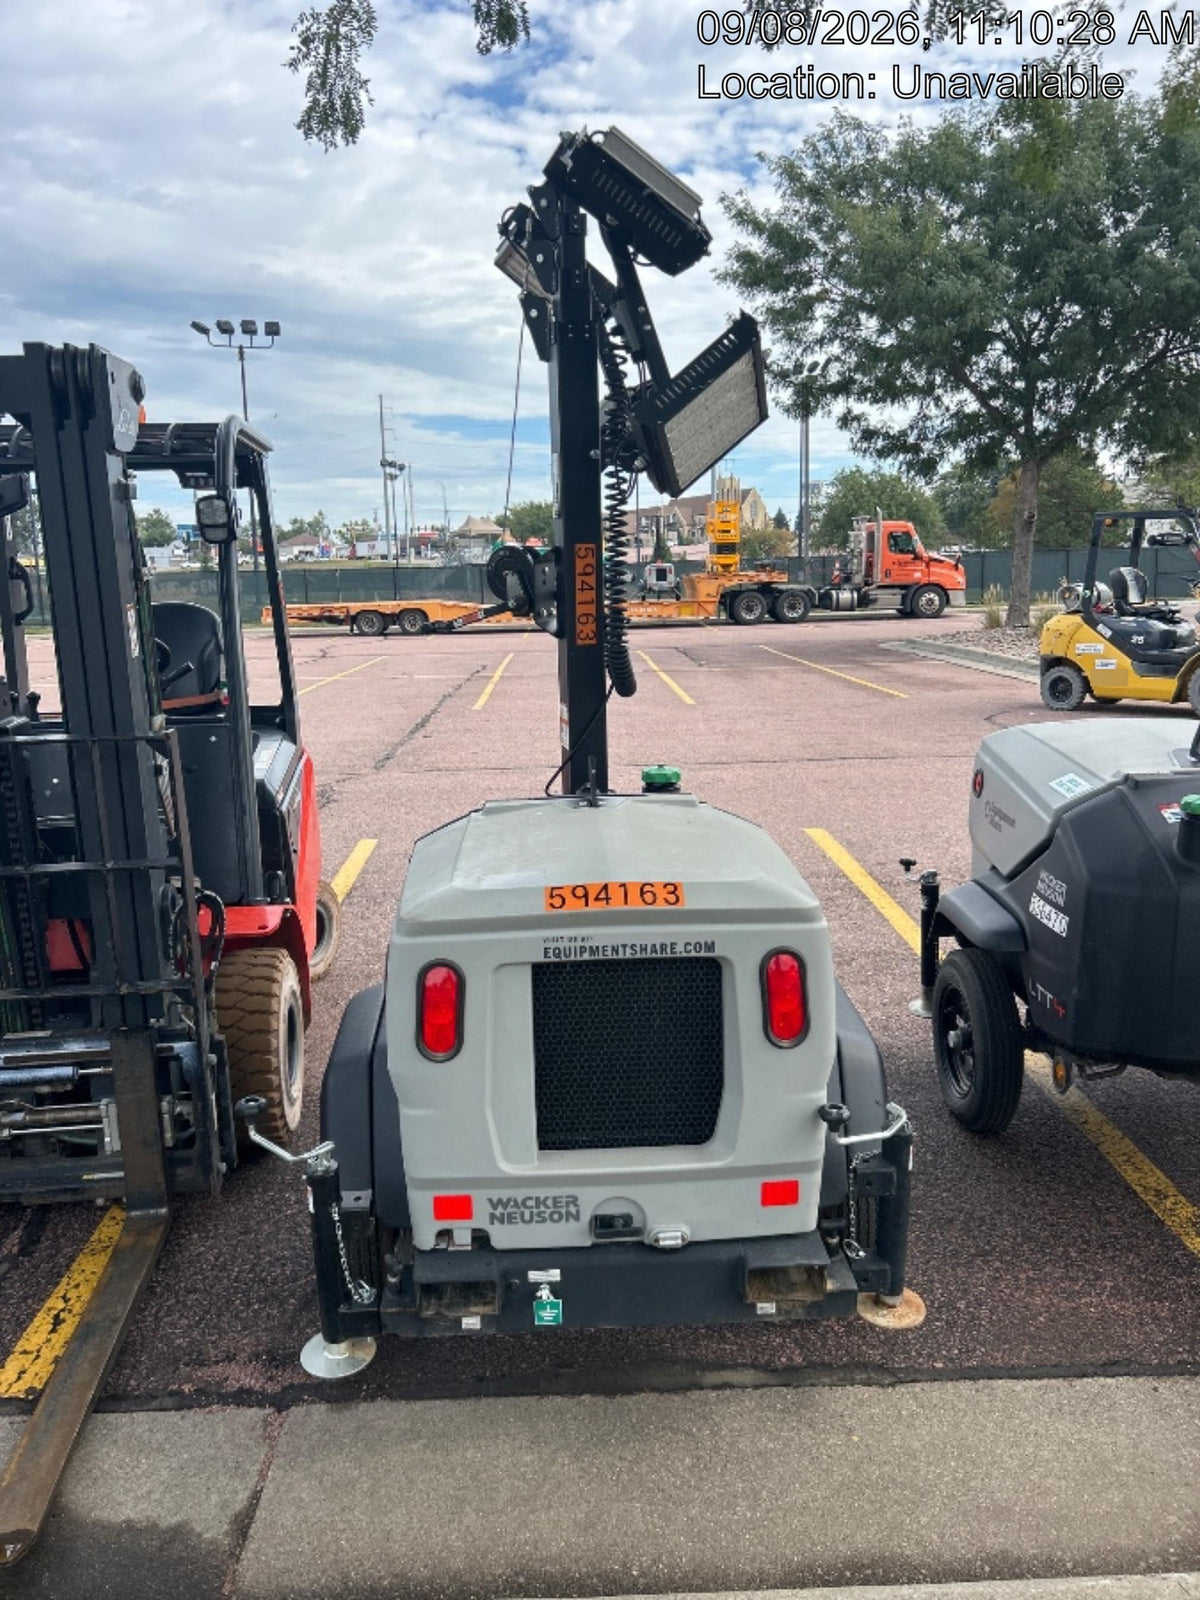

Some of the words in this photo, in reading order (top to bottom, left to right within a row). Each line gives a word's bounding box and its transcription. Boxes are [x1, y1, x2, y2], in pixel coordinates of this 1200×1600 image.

[576, 546, 597, 641] 594163
[549, 882, 681, 910] 594163
[543, 940, 716, 960] EQUIPMENTSHARE.COM
[487, 1195, 580, 1211] WACKER
[488, 1209, 580, 1226] NEUSON
